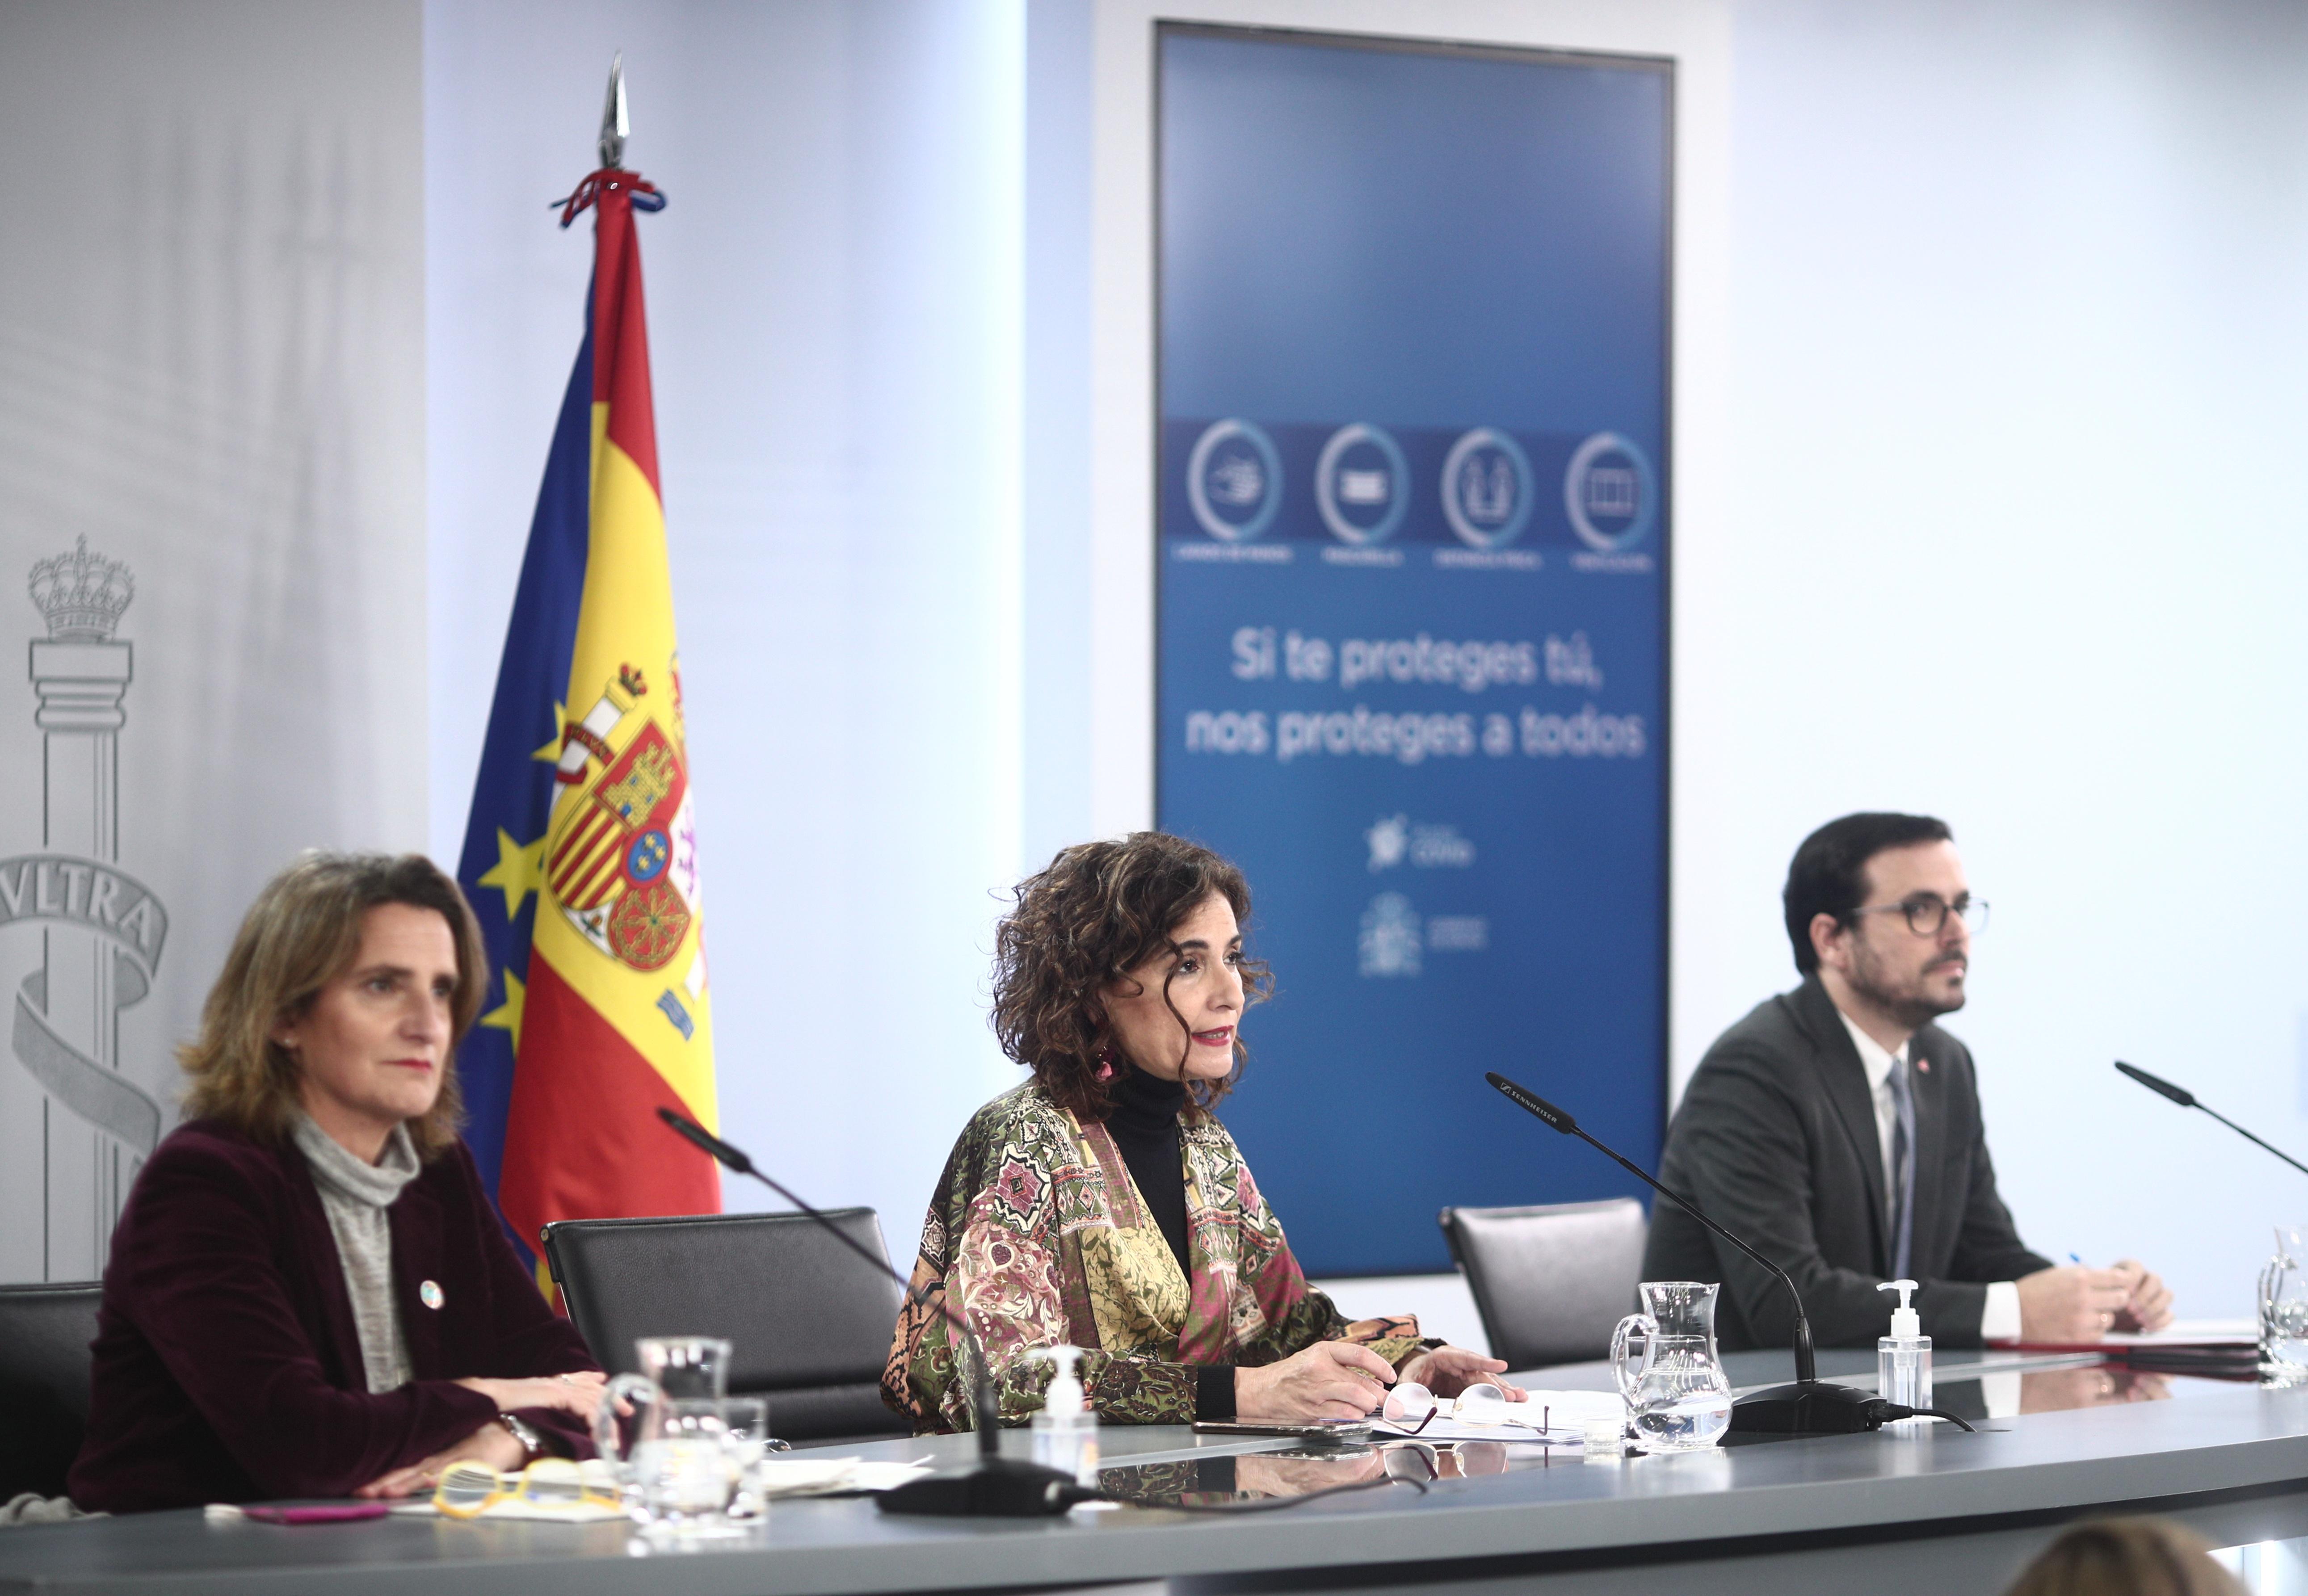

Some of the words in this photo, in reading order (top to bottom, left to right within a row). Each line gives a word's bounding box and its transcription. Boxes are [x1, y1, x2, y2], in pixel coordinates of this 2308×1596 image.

[1232, 627, 1276, 679] Si
[1286, 630, 1333, 680] te
[1341, 632, 1538, 692] proteges
[1186, 710, 1269, 753] nos
[1277, 704, 1476, 764] proteges
[1482, 711, 1513, 757] a
[1522, 703, 1646, 758] todos
[0, 861, 153, 948] VLTRA
[1511, 1090, 1558, 1123] SENNHEISER
